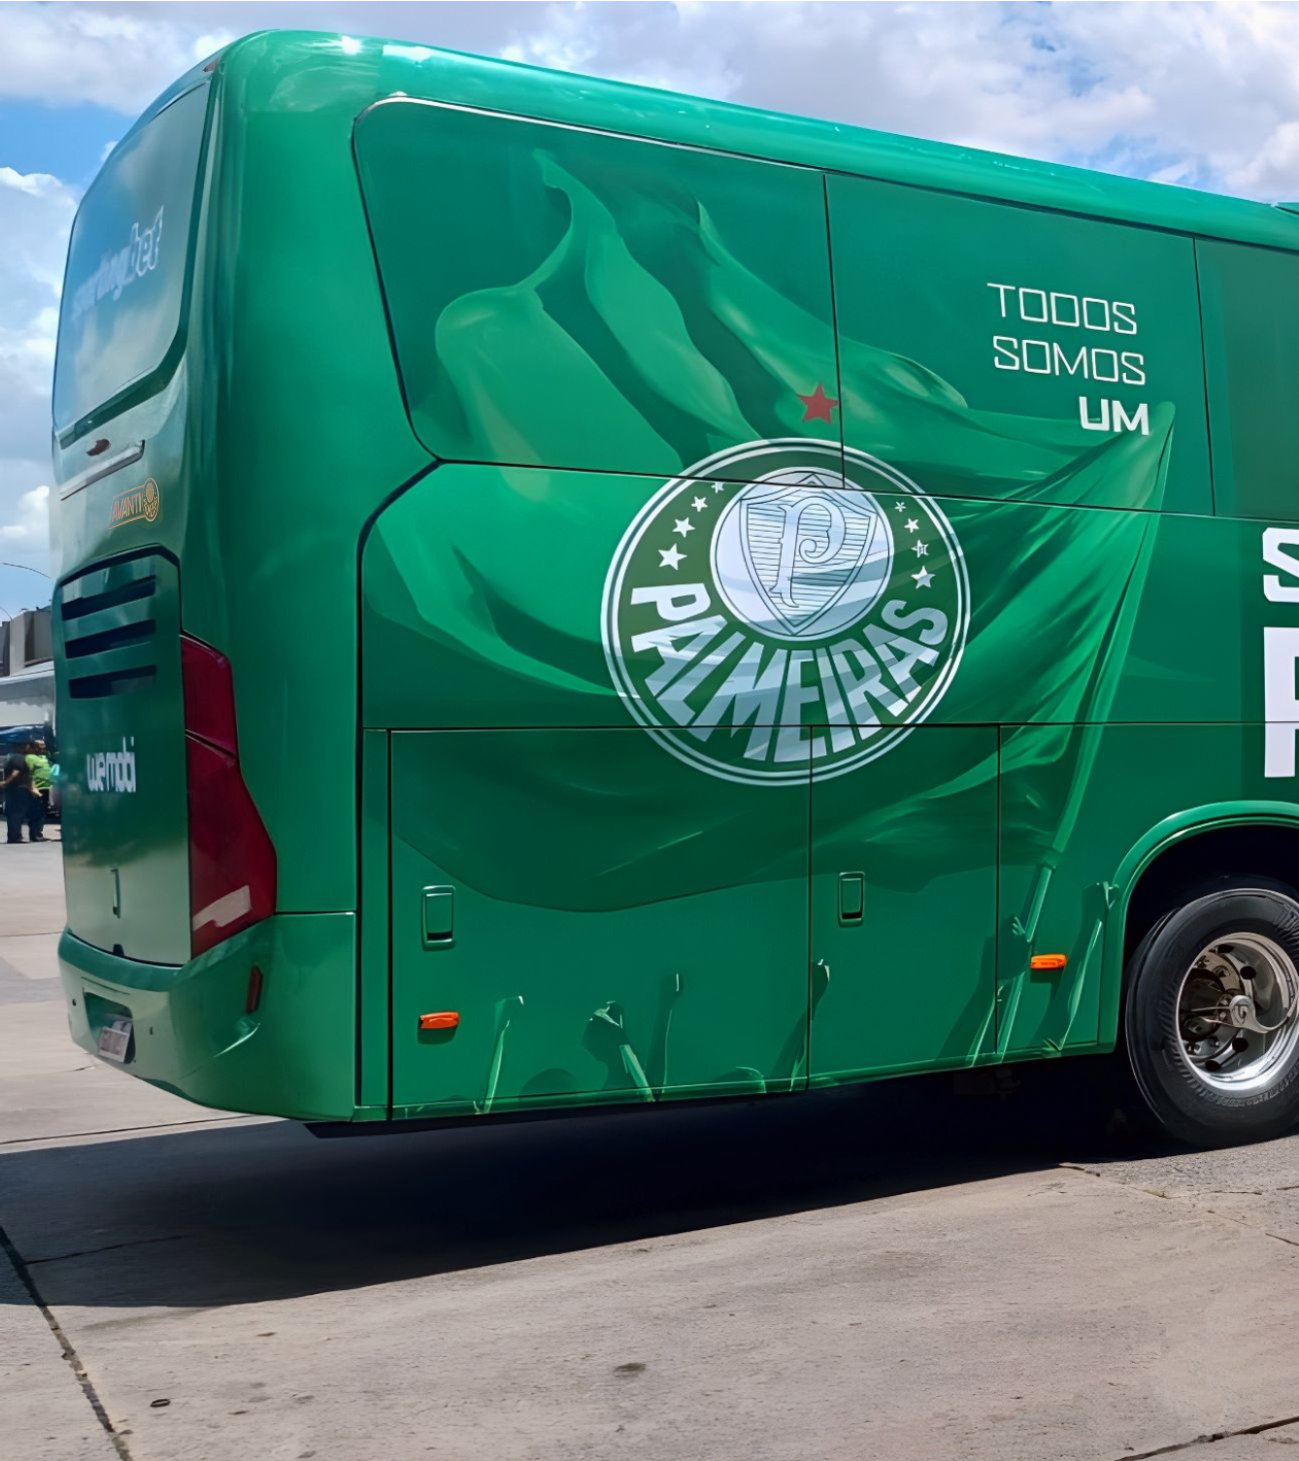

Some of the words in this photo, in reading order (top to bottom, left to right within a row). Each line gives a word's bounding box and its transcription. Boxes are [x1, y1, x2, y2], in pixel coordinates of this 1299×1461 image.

[72, 205, 164, 322] rtingbet
[987, 282, 1138, 335] TODOS
[993, 336, 1146, 386] SOMOS
[1079, 396, 1150, 436] UM
[631, 583, 949, 763] PALMEIRAS
